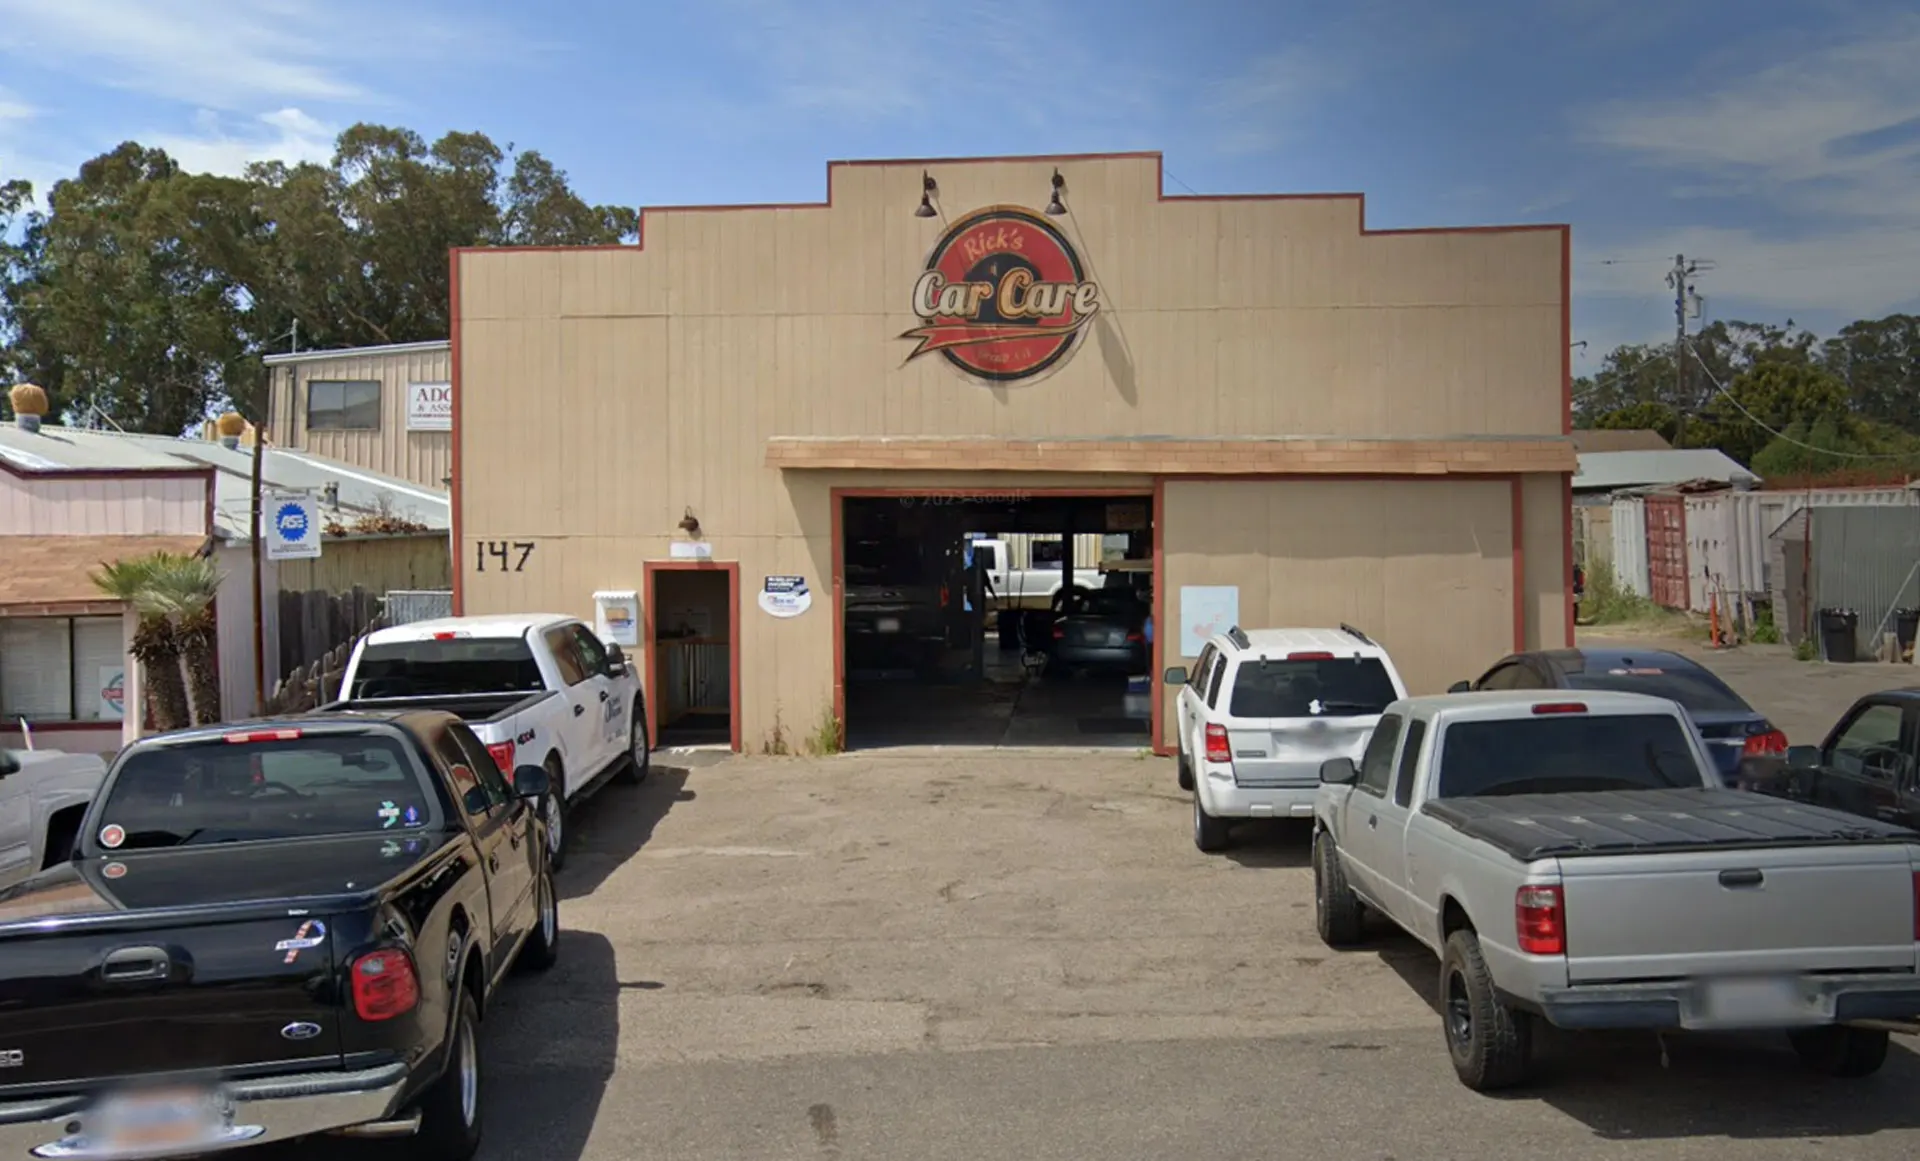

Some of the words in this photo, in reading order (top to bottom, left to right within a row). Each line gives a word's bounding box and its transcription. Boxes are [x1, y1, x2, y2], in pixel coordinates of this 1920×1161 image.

[963, 227, 1024, 261] Rick's
[913, 268, 993, 319] Car
[997, 267, 1100, 319] Care
[280, 514, 305, 529] ASE
[476, 541, 534, 572] 147
